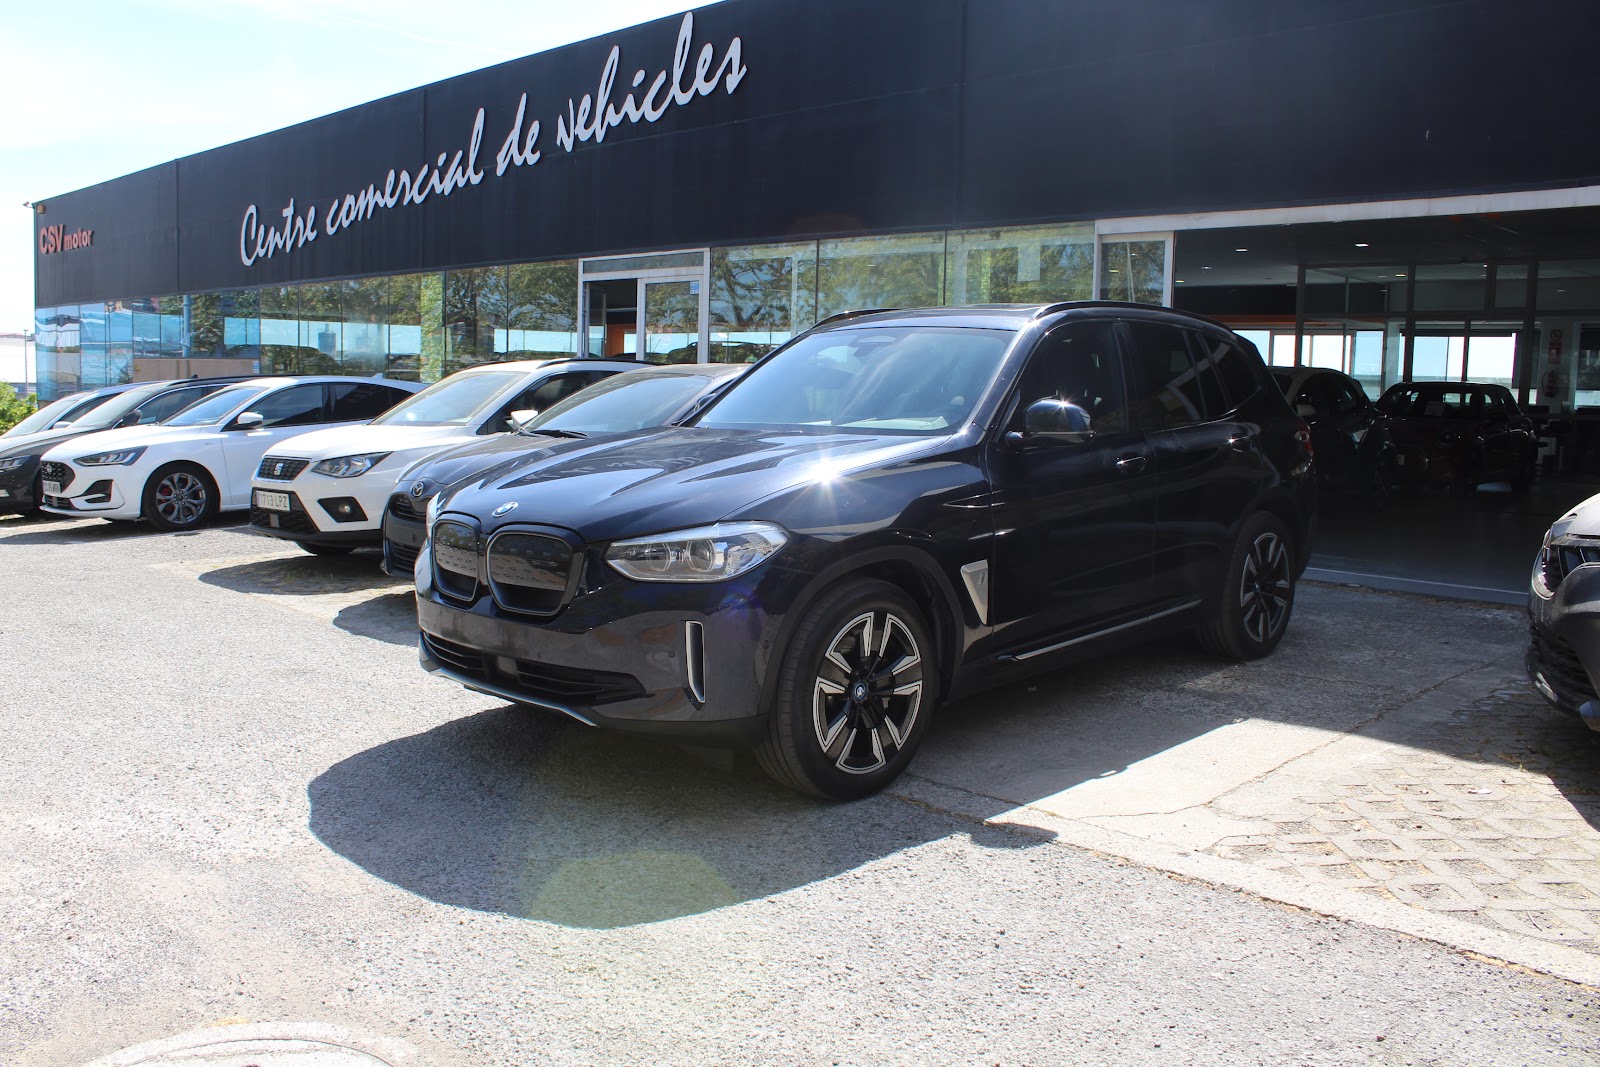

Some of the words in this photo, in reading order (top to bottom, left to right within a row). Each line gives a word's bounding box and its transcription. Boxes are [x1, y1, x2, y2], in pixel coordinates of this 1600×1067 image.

[240, 197, 318, 267] Centre
[325, 107, 485, 236] comercial
[496, 92, 541, 177] de
[556, 11, 748, 154] vehicles
[40, 224, 64, 254] CSV
[64, 228, 92, 251] motor
[275, 495, 288, 508] LPZ
